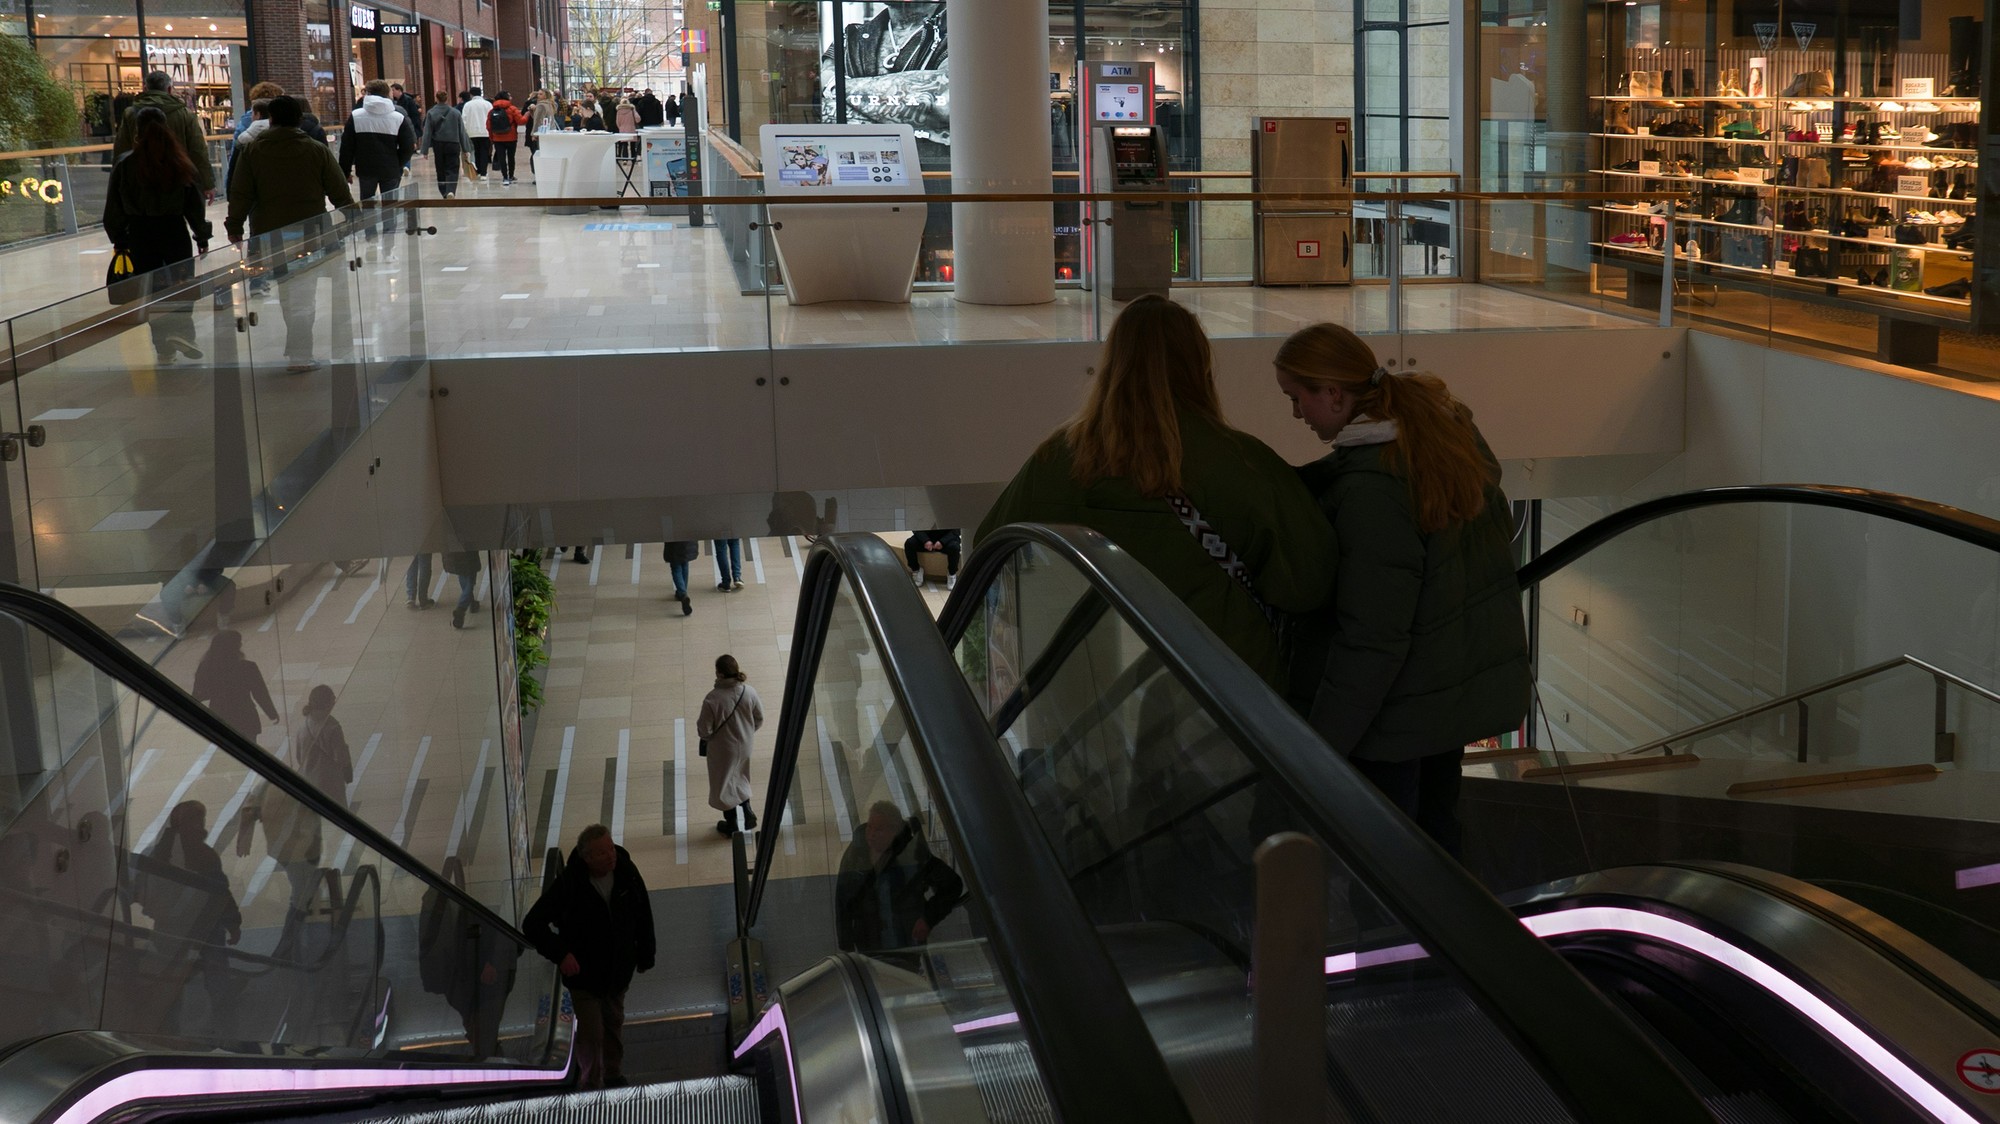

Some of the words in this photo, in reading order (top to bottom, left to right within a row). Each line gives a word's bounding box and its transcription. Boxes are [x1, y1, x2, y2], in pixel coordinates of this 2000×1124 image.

[352, 5, 375, 30] GUESS
[383, 25, 418, 34] GUESS
[145, 43, 177, 56] Denim
[1111, 66, 1132, 76] ATM
[1305, 245, 1312, 254] B
